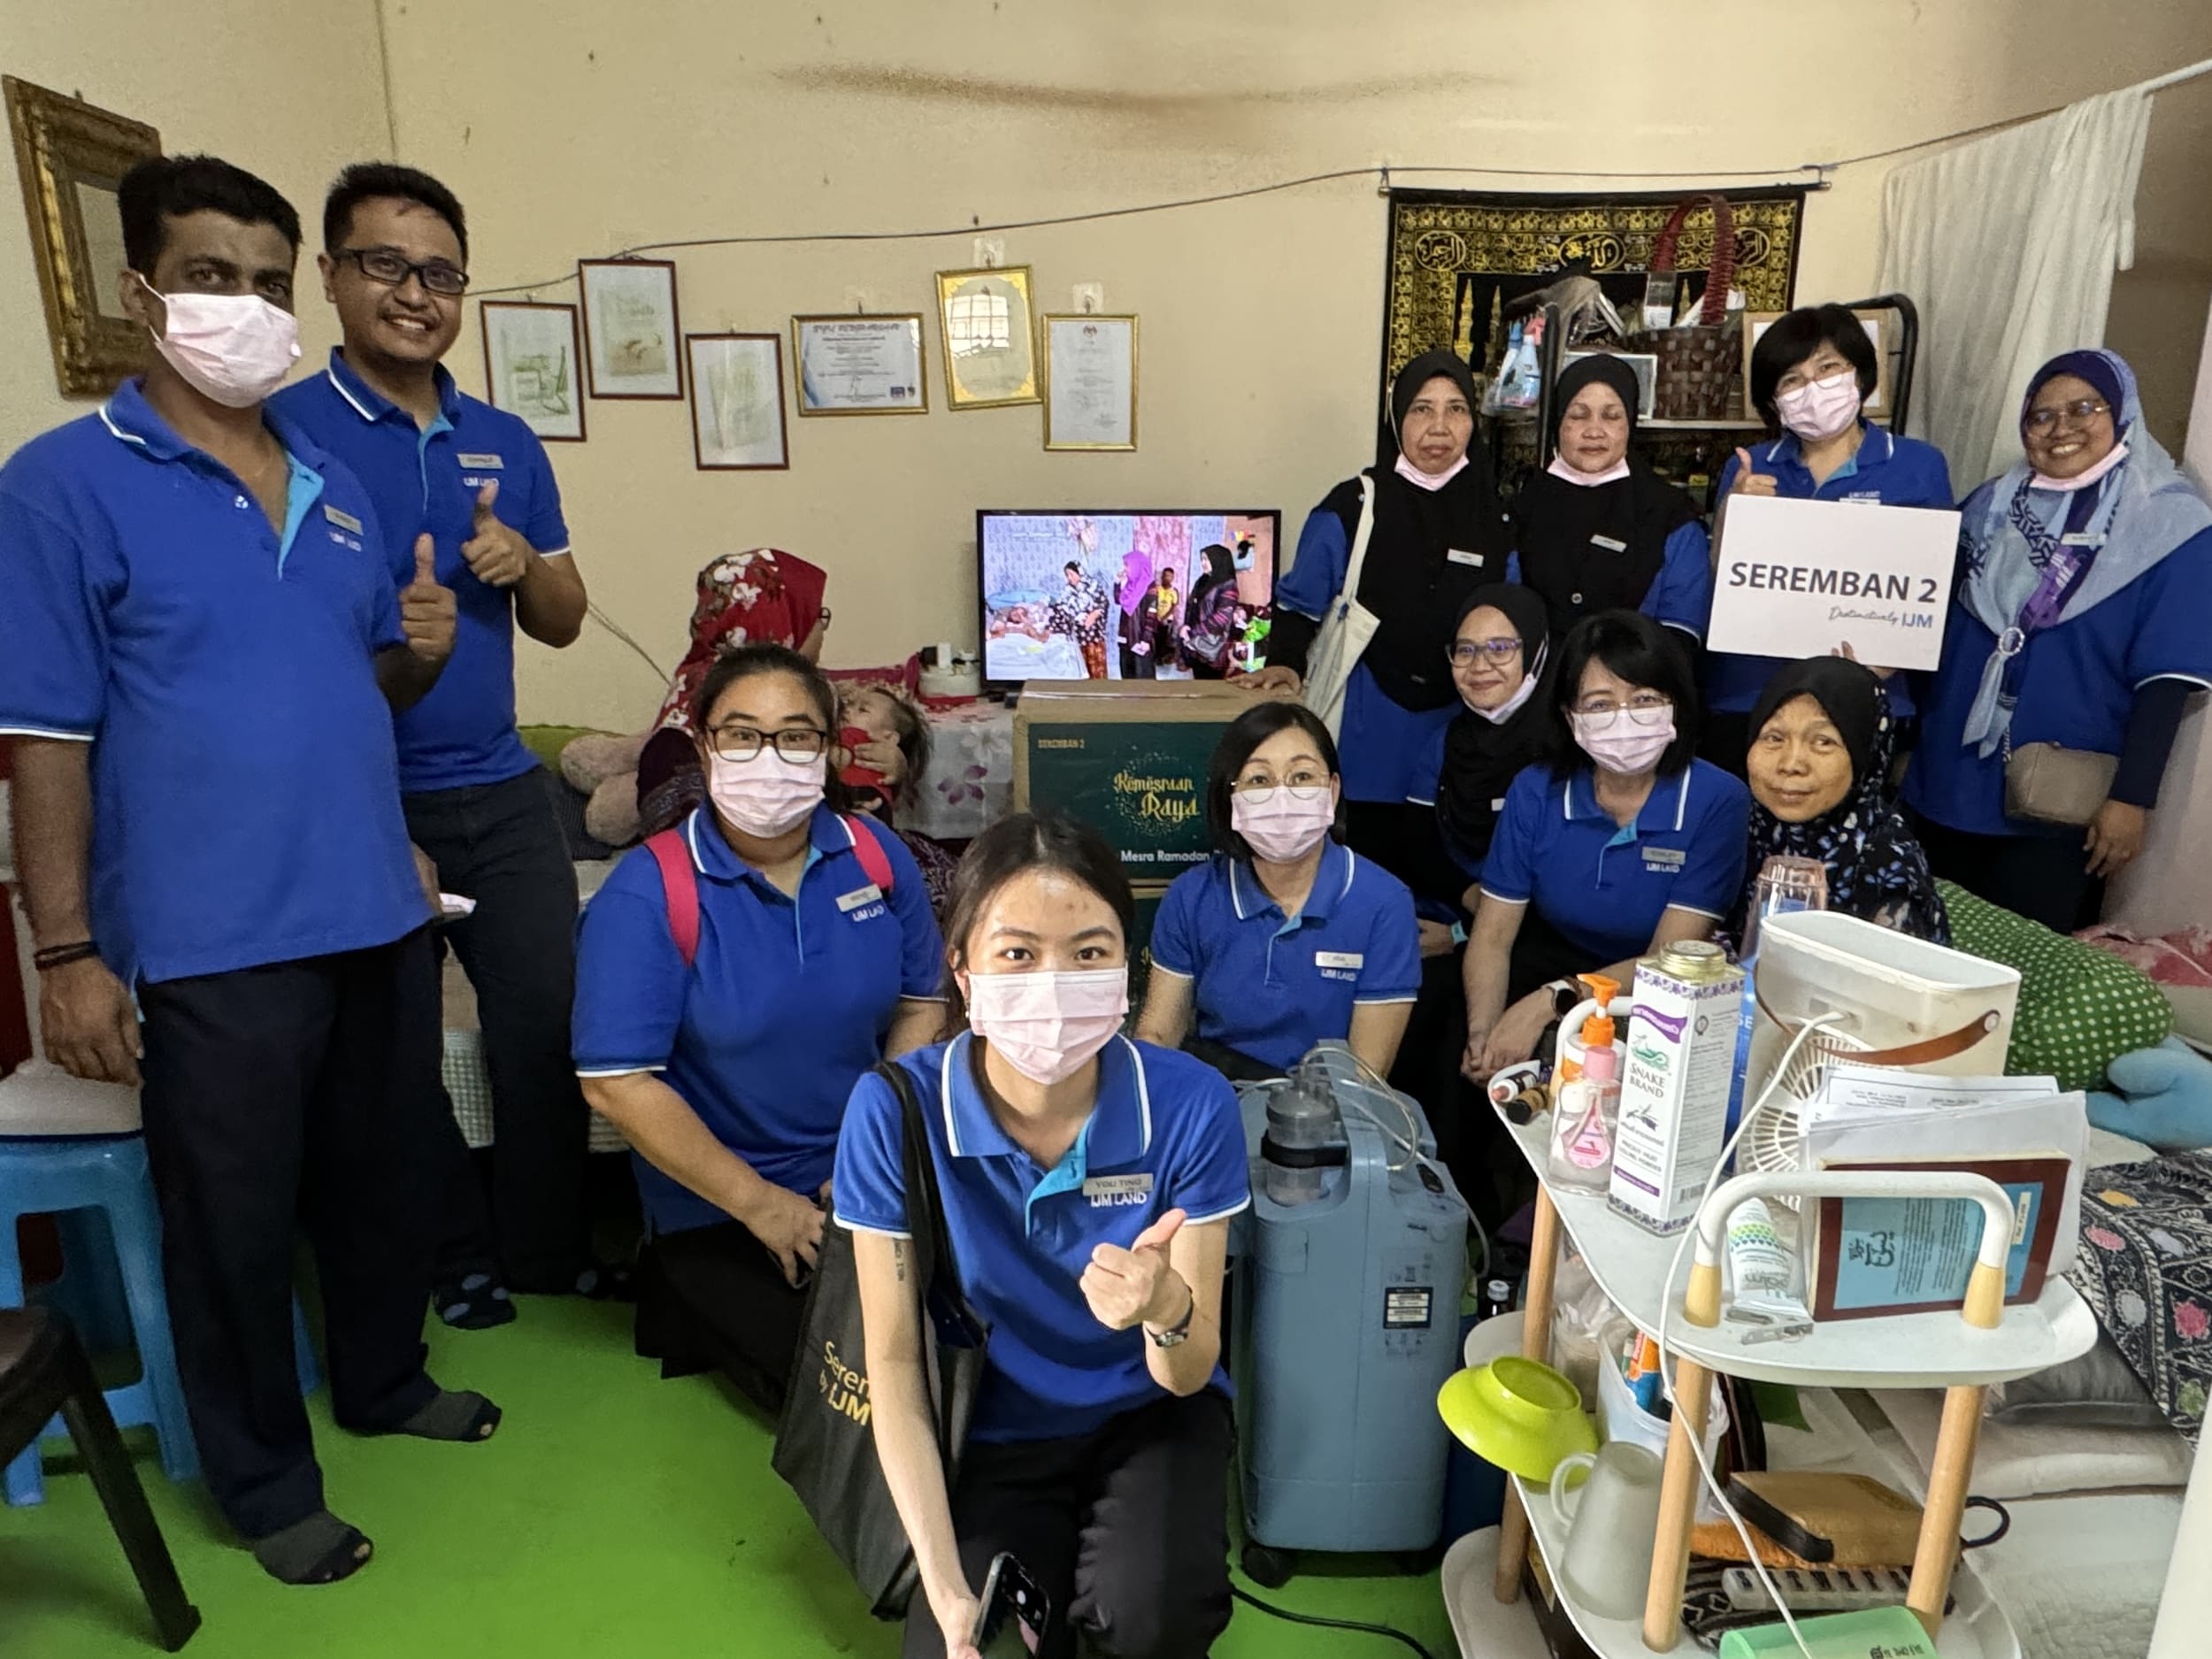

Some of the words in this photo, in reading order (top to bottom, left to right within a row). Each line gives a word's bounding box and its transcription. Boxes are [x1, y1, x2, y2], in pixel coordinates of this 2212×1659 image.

[1729, 561, 1910, 602] SEREMBAN
[1916, 578, 1938, 603] 2
[1901, 612, 1933, 629] IJM
[1141, 791, 1201, 823] Raya
[1120, 849, 1155, 863] Mesra
[1156, 849, 1210, 863] Ramadan
[1629, 1062, 1666, 1089] SNAKE
[1629, 1074, 1664, 1099] BRAND
[1115, 1191, 1148, 1206] LAND
[827, 1382, 872, 1426] IJM
